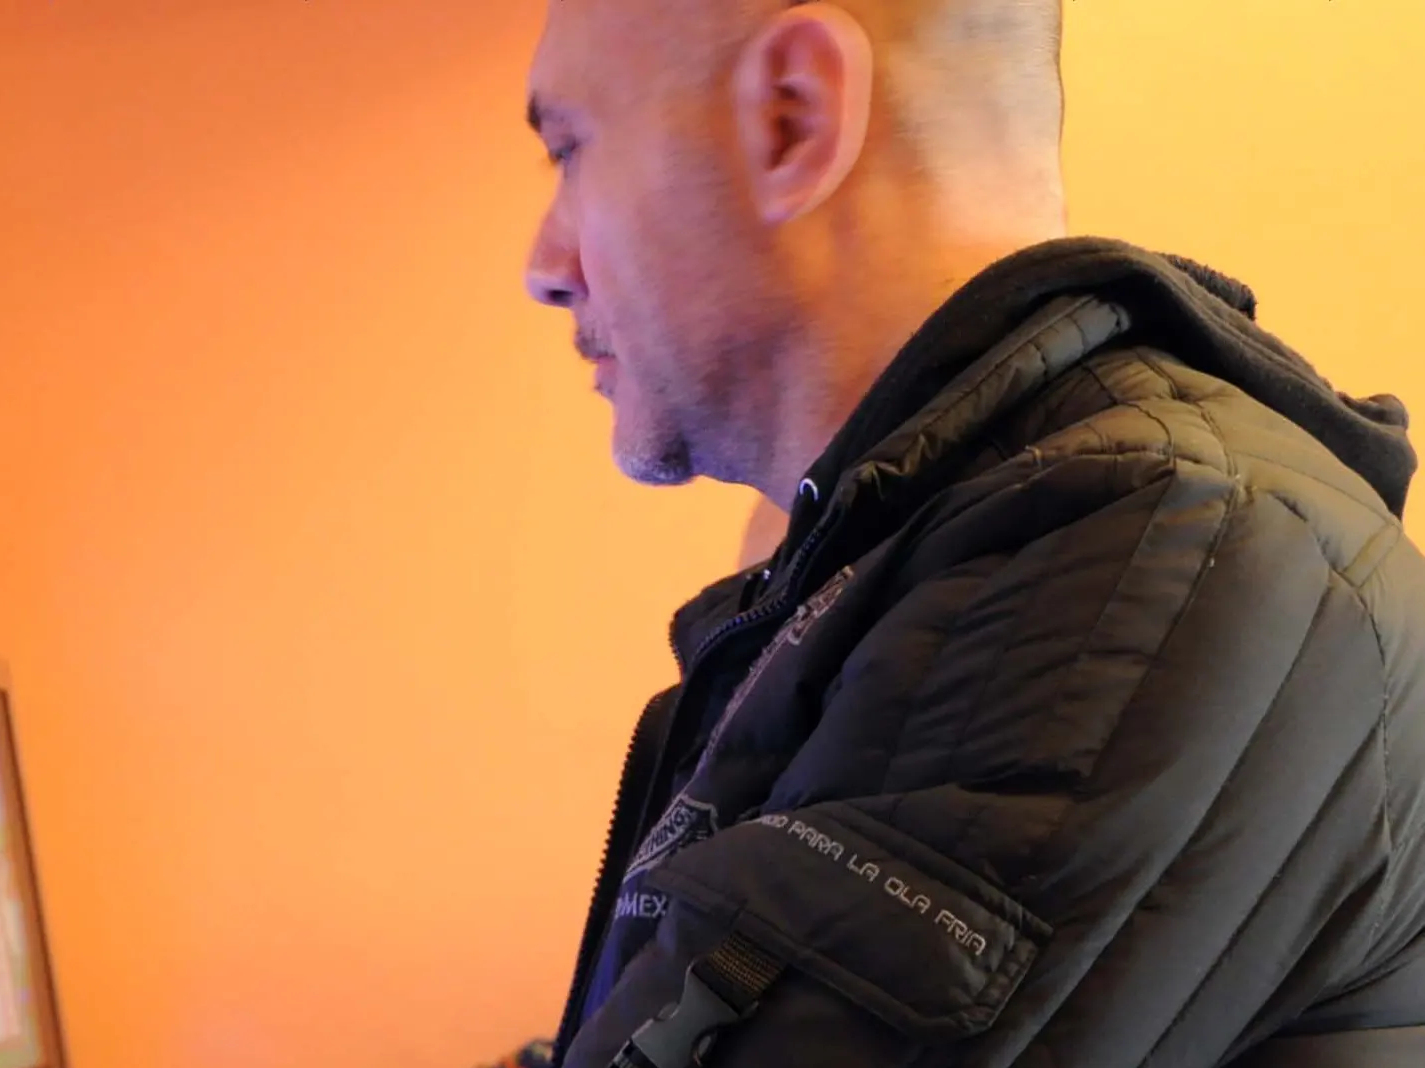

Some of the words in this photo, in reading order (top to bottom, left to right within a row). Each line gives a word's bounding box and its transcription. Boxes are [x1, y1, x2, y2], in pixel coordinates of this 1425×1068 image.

[787, 820, 845, 862] PARA
[846, 854, 880, 882] LA
[884, 876, 931, 914] OLA
[934, 909, 986, 956] FRIA
